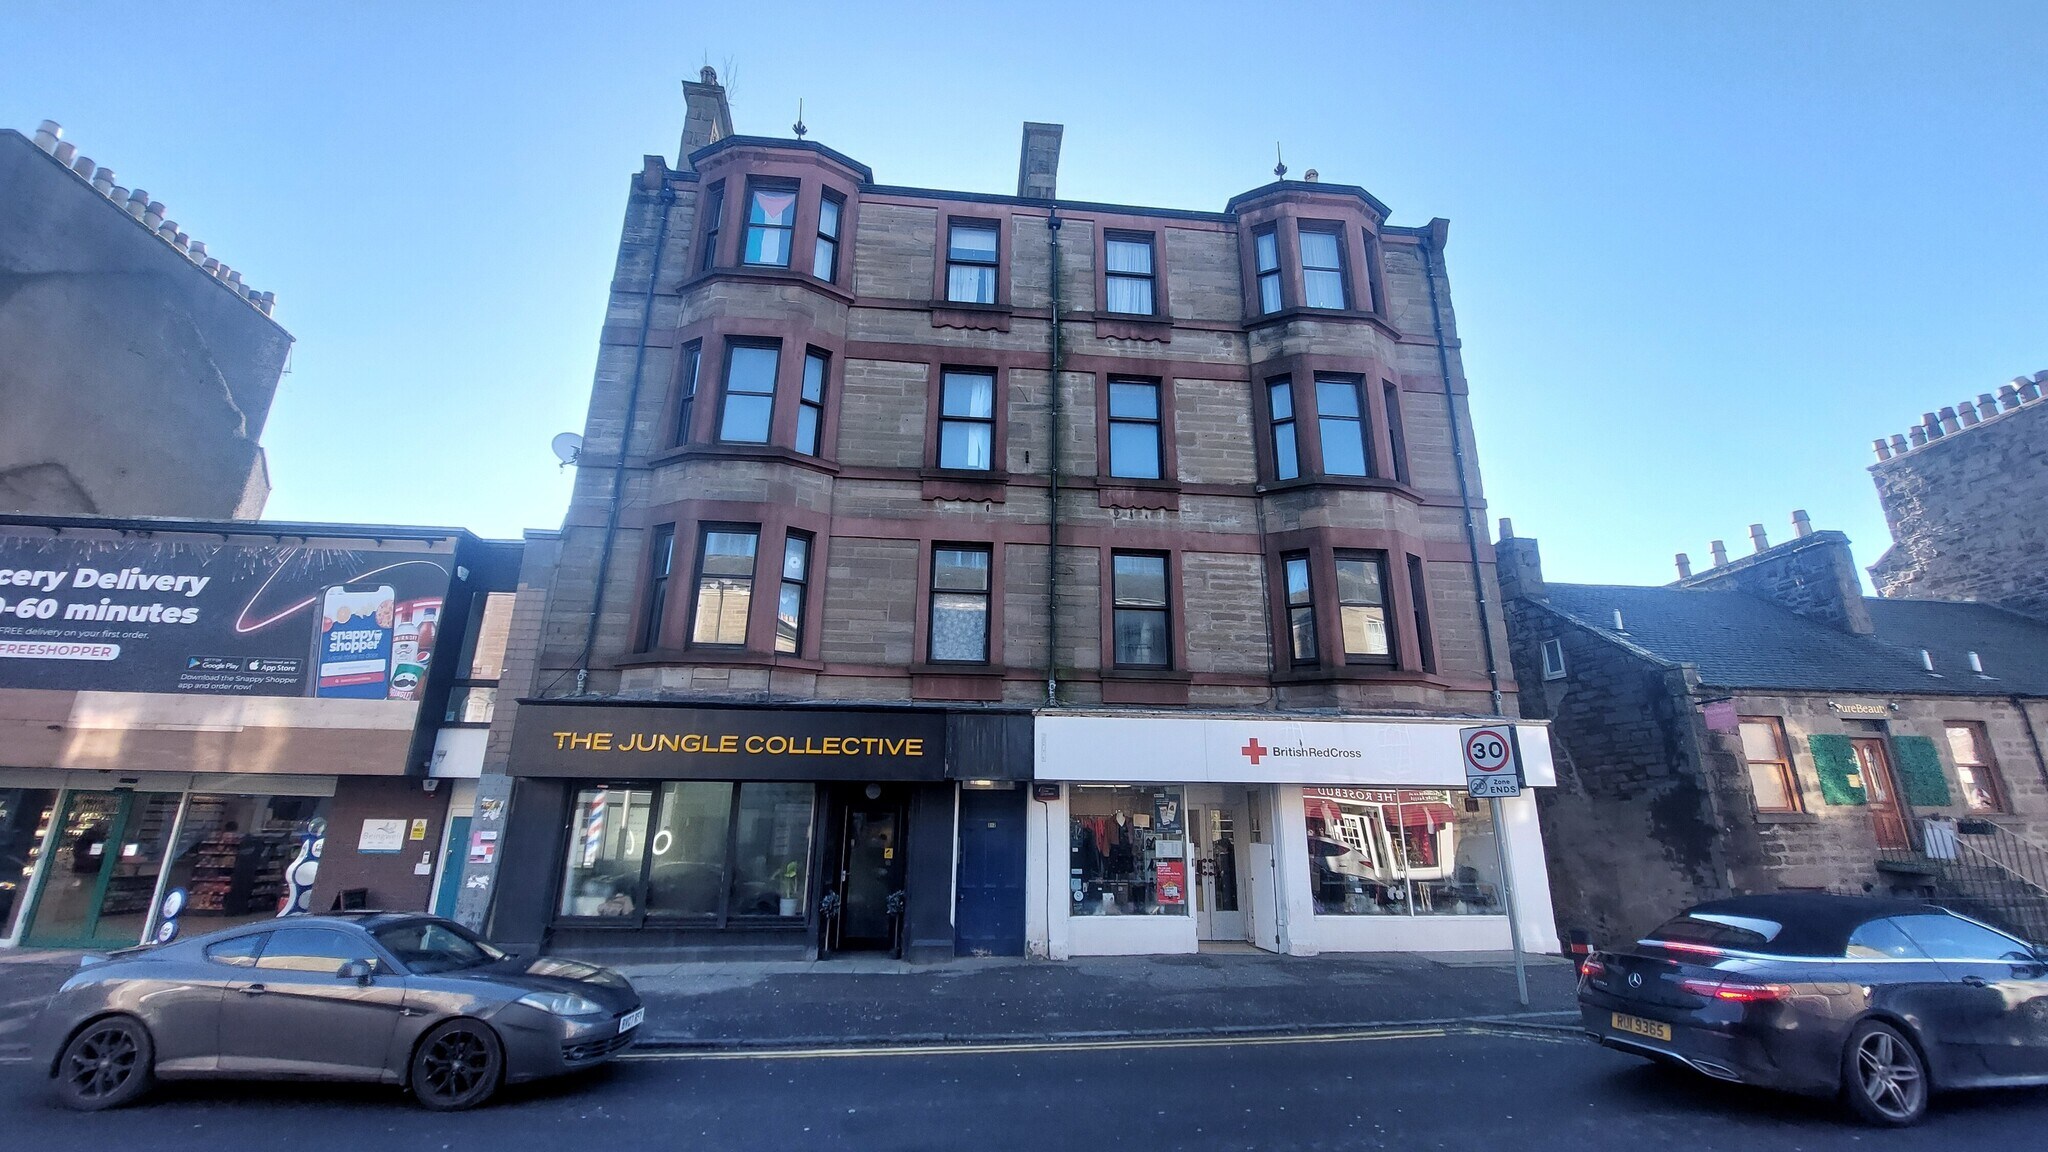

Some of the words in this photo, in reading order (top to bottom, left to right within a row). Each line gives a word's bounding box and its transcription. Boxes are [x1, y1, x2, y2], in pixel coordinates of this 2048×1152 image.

[0, 569, 68, 592] cery
[72, 567, 211, 597] Delivery
[64, 598, 200, 624] minutes
[25, 627, 62, 638] delivery
[78, 630, 100, 638] your
[102, 629, 120, 638] first
[122, 630, 150, 639] order.
[330, 630, 374, 643] snappy
[329, 640, 380, 653] shopper
[202, 662, 225, 670] Google
[553, 732, 614, 751] THE
[618, 733, 739, 753] JUNGLE
[745, 735, 924, 756] COLLECTIVE
[1472, 741, 1503, 760] 30
[1272, 746, 1362, 758] BritishRedCross
[1490, 785, 1517, 794] ENDS
[1616, 1014, 1633, 1030] RUI
[1635, 1018, 1664, 1037] 9365
